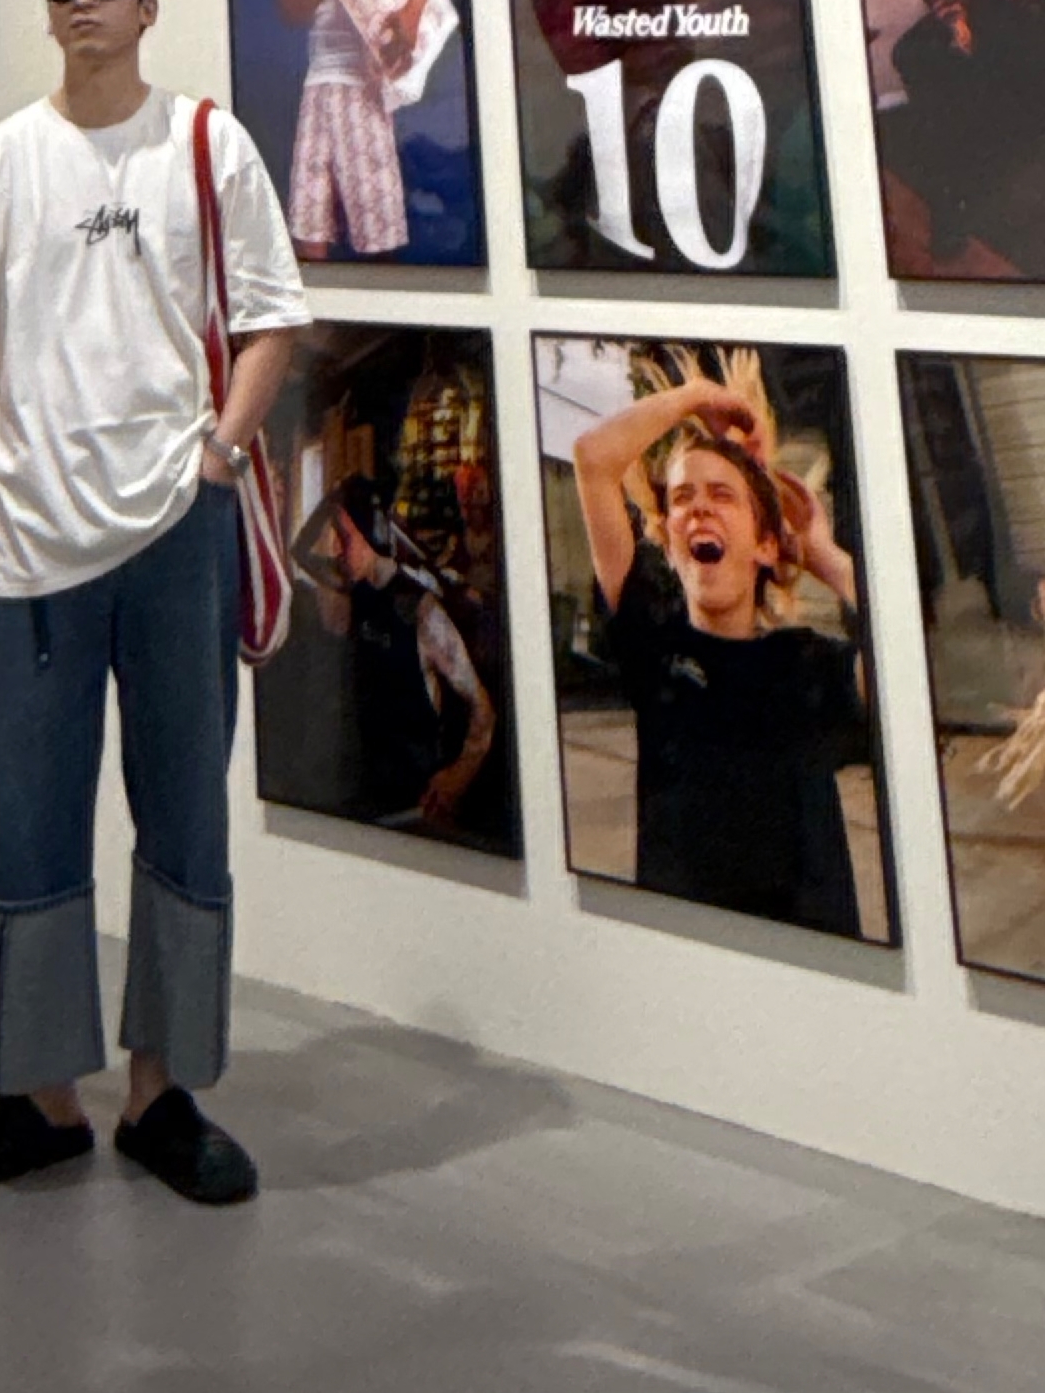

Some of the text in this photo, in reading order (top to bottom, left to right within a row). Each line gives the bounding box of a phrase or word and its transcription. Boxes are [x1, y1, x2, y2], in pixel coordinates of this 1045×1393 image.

[573, 4, 750, 38] Wasted Youth
[566, 58, 767, 270] 10
